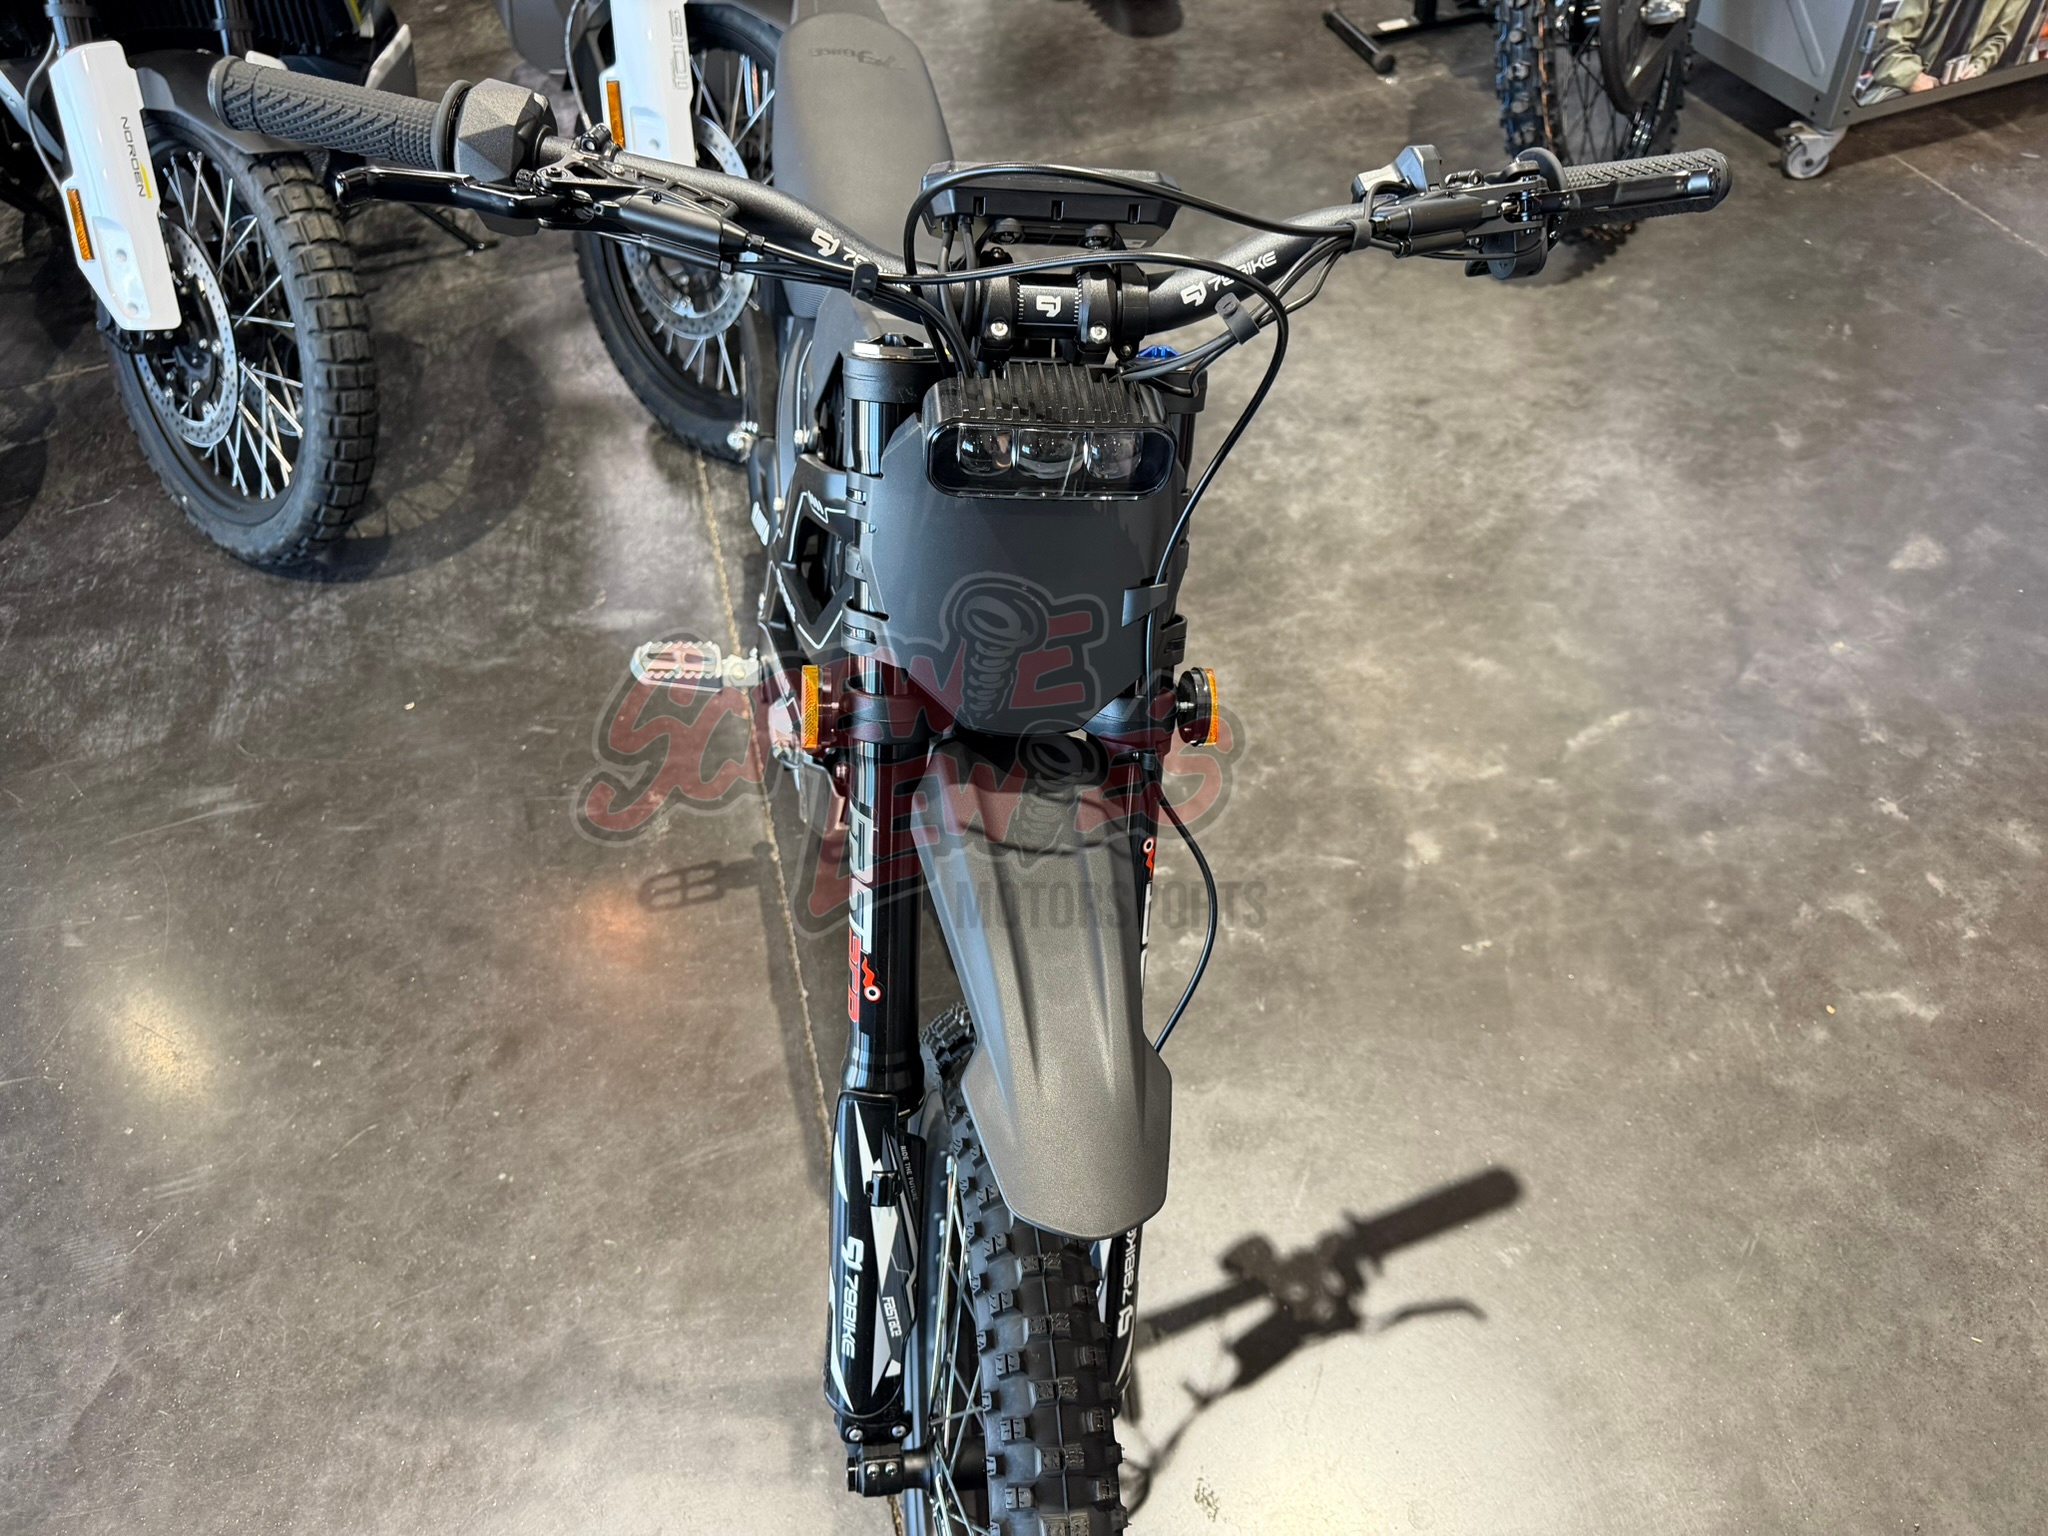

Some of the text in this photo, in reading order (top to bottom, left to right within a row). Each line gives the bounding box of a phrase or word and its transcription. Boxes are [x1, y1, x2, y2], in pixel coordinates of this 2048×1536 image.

[120, 116, 146, 197] NORDEN
[900, 1144, 919, 1202] RIDE THE FUTURE
[841, 1273, 860, 1360] 79BIKE
